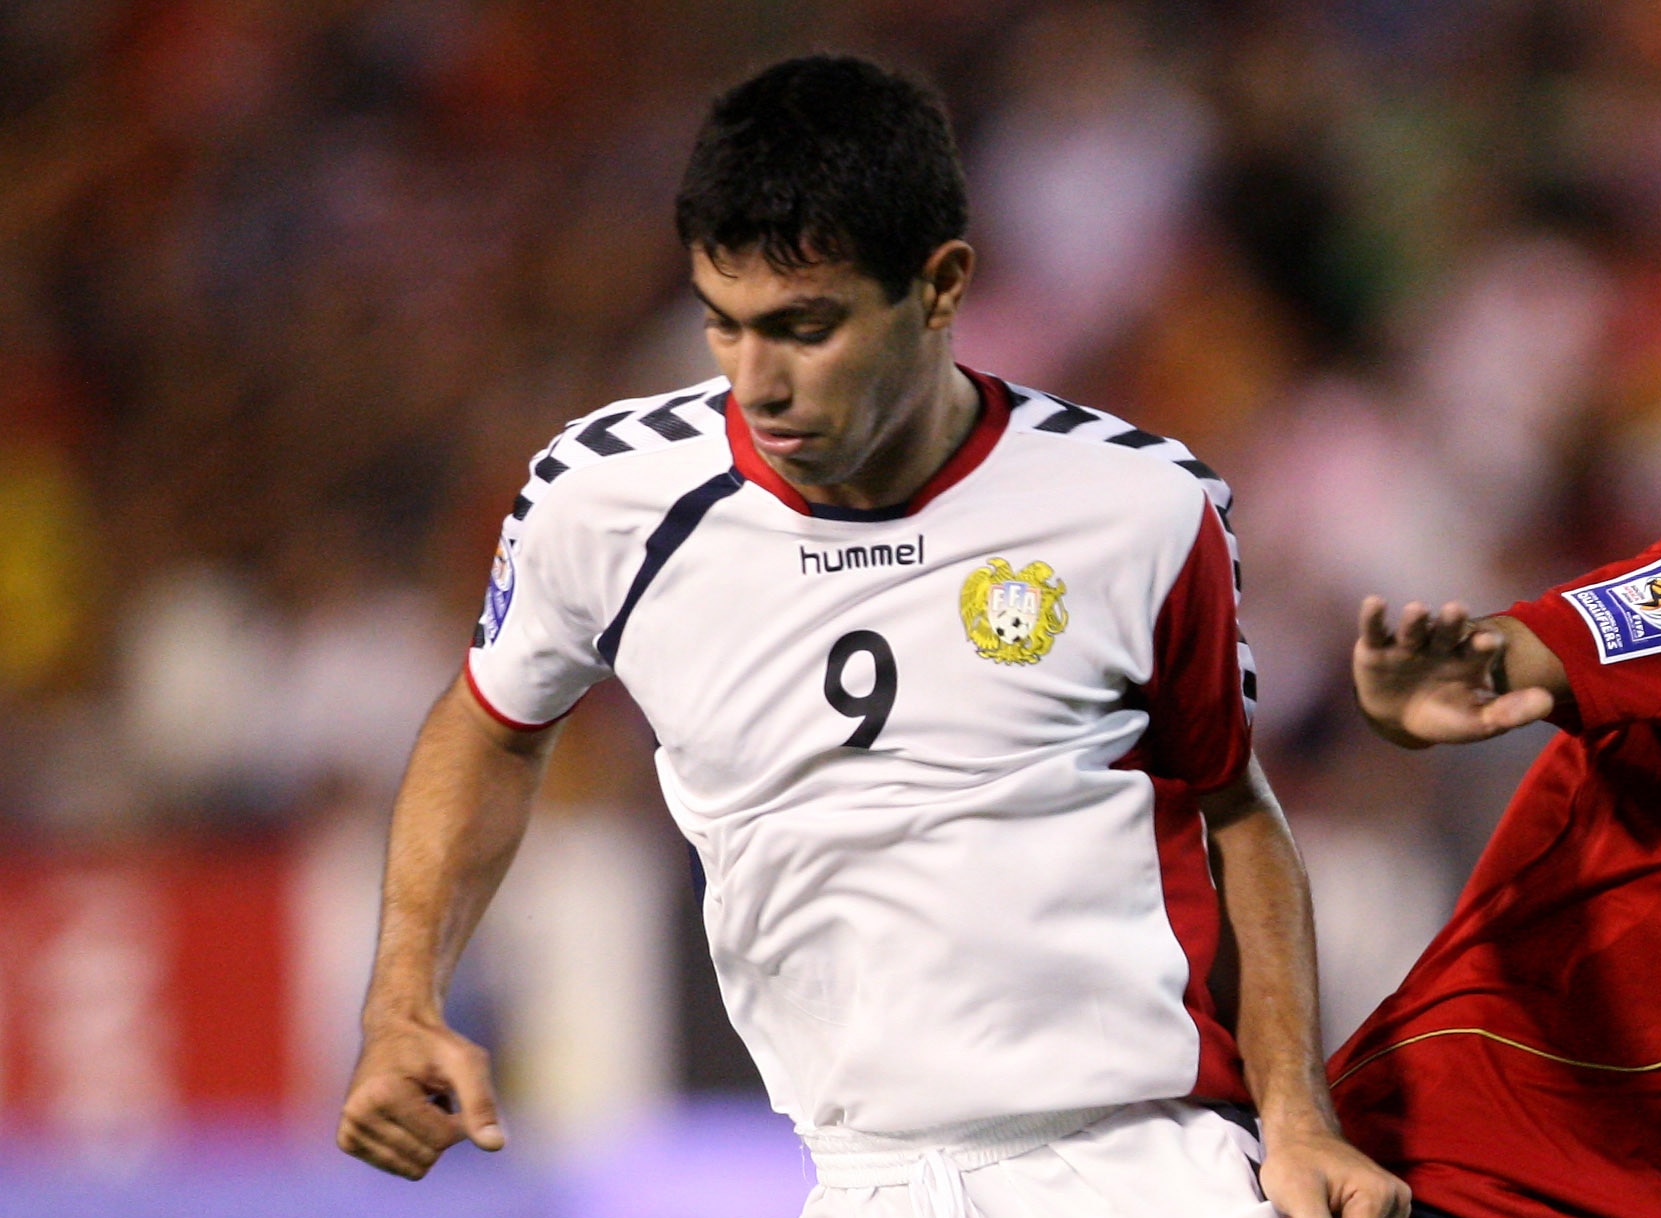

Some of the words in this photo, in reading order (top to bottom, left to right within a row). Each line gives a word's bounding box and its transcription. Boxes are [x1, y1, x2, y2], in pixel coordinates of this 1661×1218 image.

[800, 534, 924, 575] hummel
[992, 584, 1037, 614] FFA
[1577, 591, 1618, 650] QUALIFIERS
[1632, 614, 1645, 638] FIFA
[824, 629, 898, 750] 9
